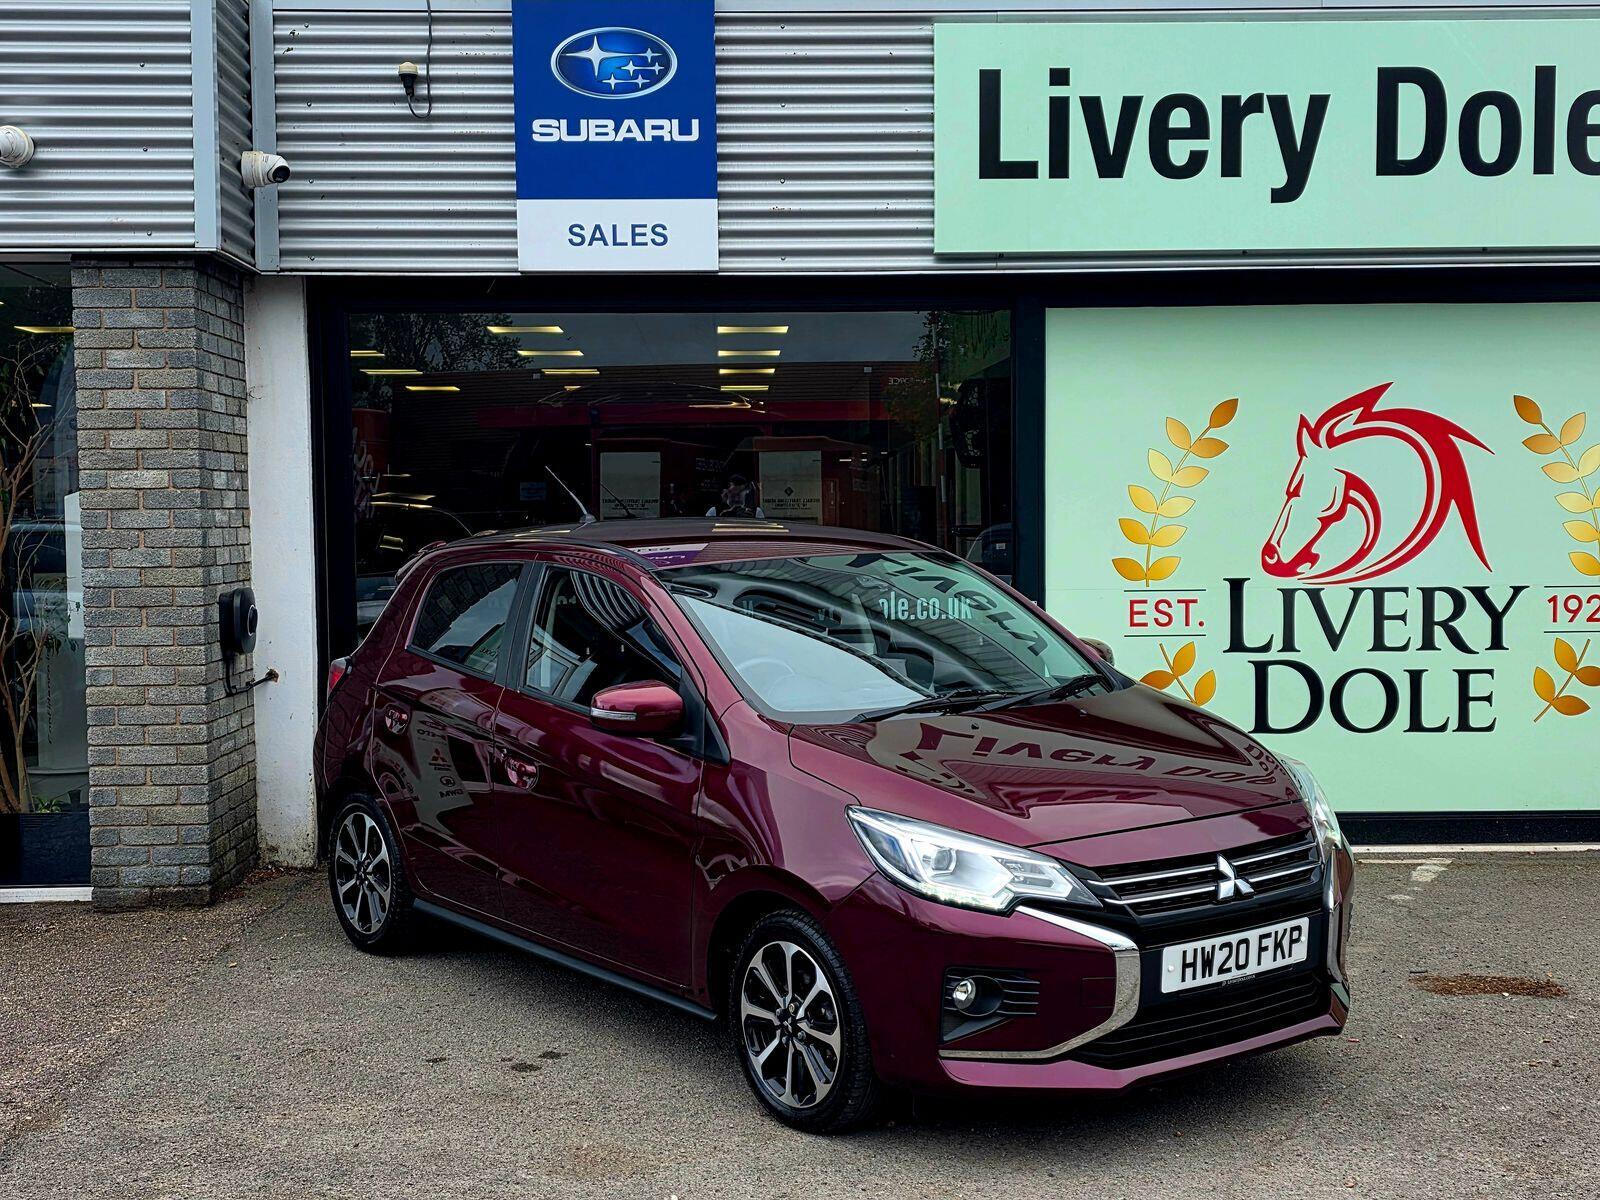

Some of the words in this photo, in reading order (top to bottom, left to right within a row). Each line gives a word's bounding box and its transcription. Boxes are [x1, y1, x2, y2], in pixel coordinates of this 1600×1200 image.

[532, 118, 700, 142] SUBARU
[979, 68, 1331, 204] Livery
[1376, 65, 1600, 177] Dole
[567, 223, 669, 247] SALES
[1128, 598, 1206, 628] EST.
[1223, 577, 1530, 655] LIVERY
[1547, 593, 1600, 623] 192
[1249, 660, 1497, 734] DOLE
[1180, 937, 1250, 983] HW20
[1257, 925, 1303, 966] FKP
